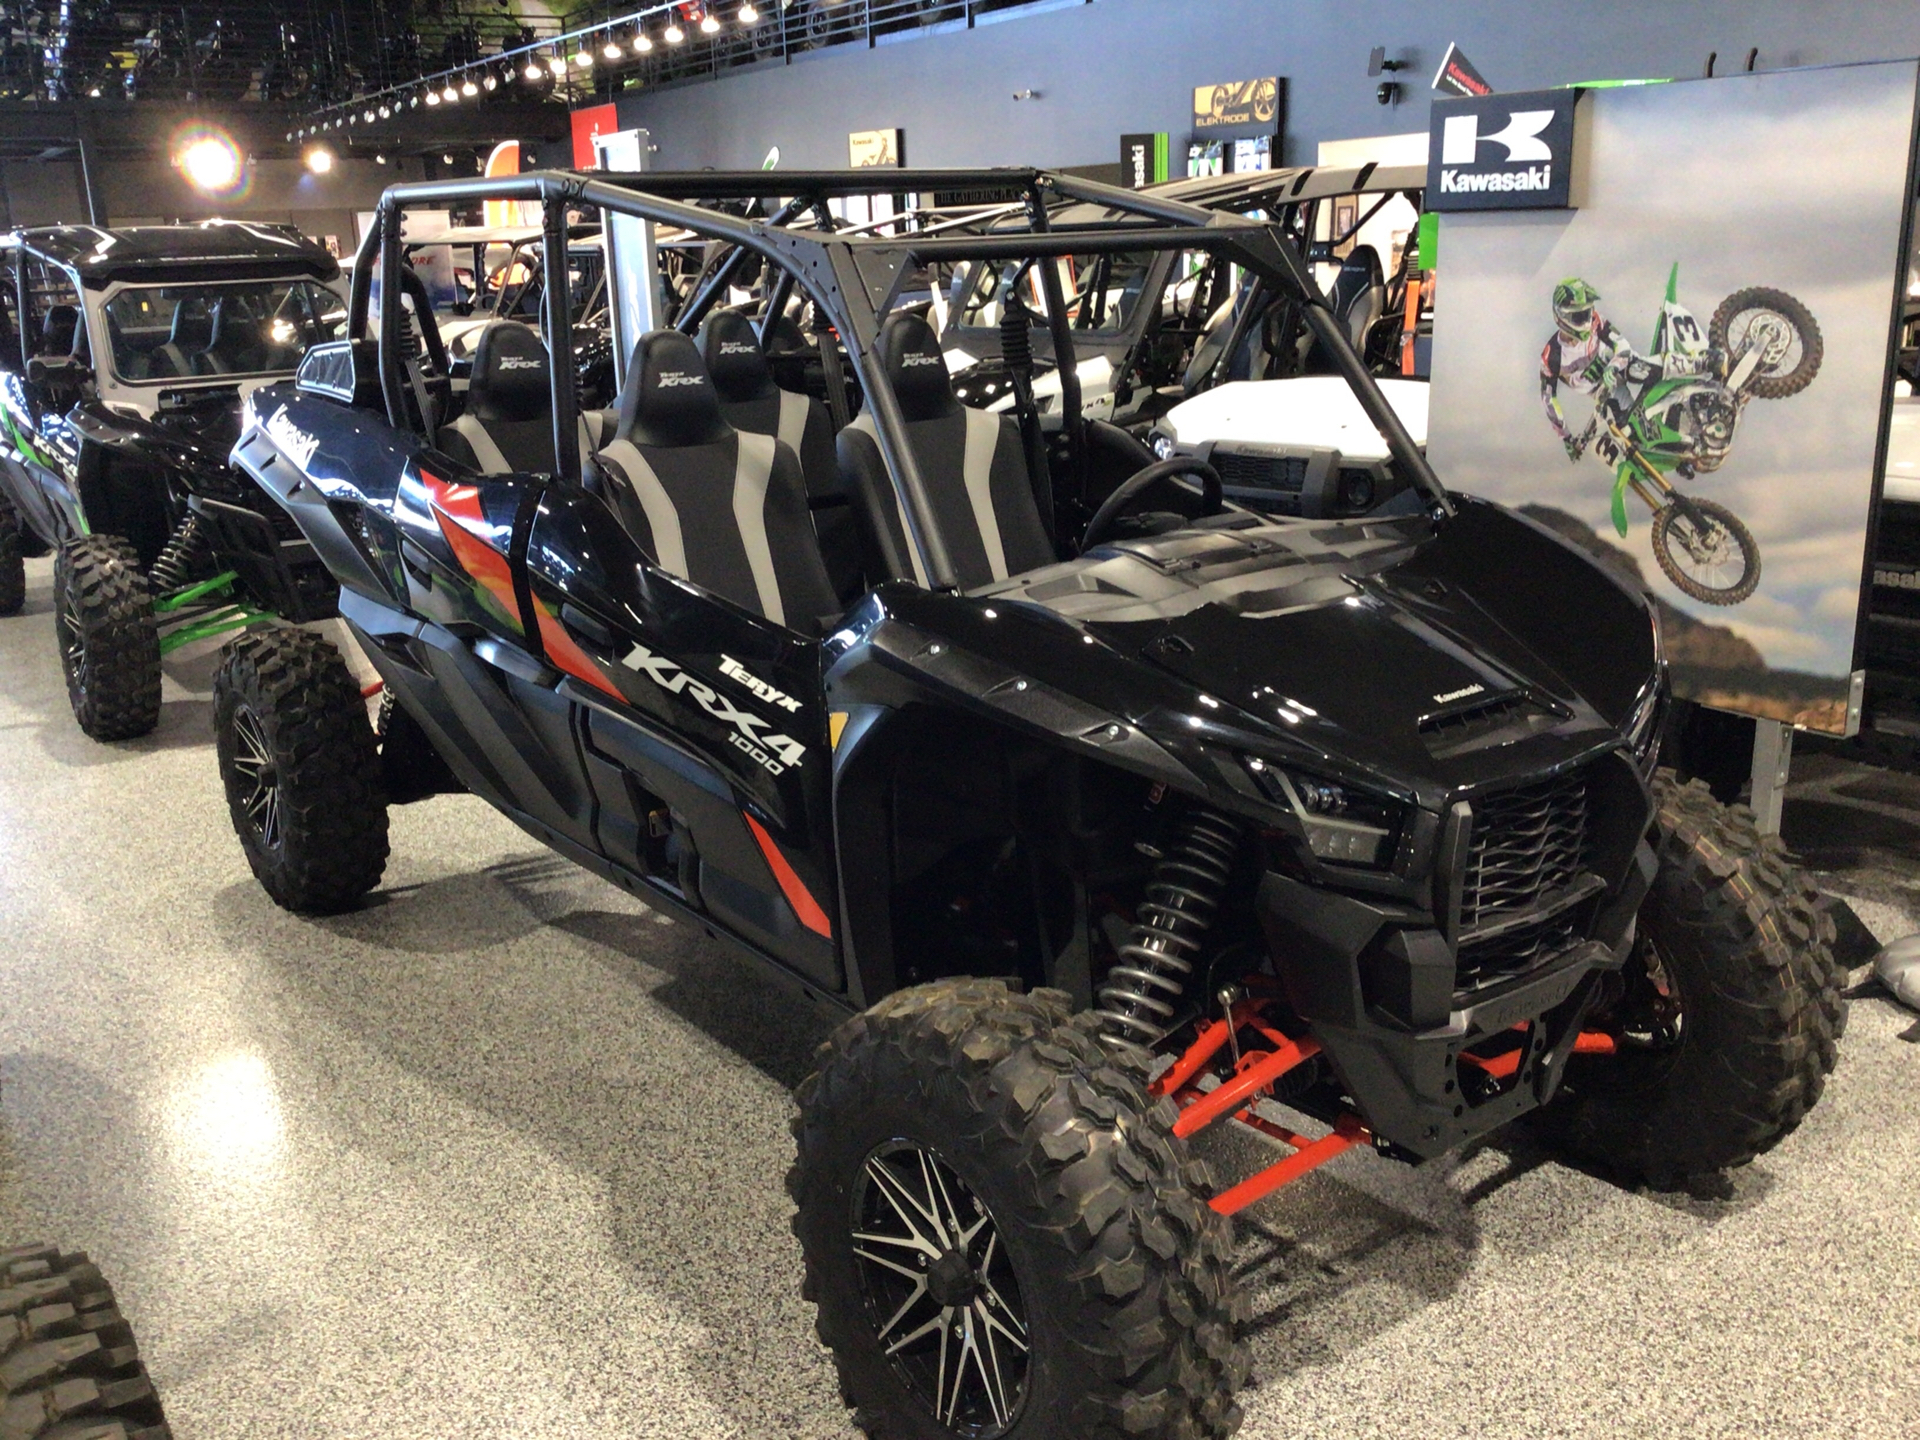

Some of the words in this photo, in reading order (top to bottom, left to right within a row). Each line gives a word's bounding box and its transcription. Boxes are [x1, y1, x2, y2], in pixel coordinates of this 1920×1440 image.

[1448, 61, 1490, 96] Kawasaki
[1195, 112, 1250, 127] ELEKTRODE
[1131, 144, 1145, 189] asaki
[1441, 165, 1551, 193] Kawasaki
[1672, 315, 1700, 342] 3
[498, 360, 541, 370] KRX
[901, 356, 939, 368] KRX
[657, 375, 704, 388] KRX
[621, 639, 806, 767] KRX4
[1433, 683, 1485, 704] Kawasaki
[728, 731, 785, 776] 1000
